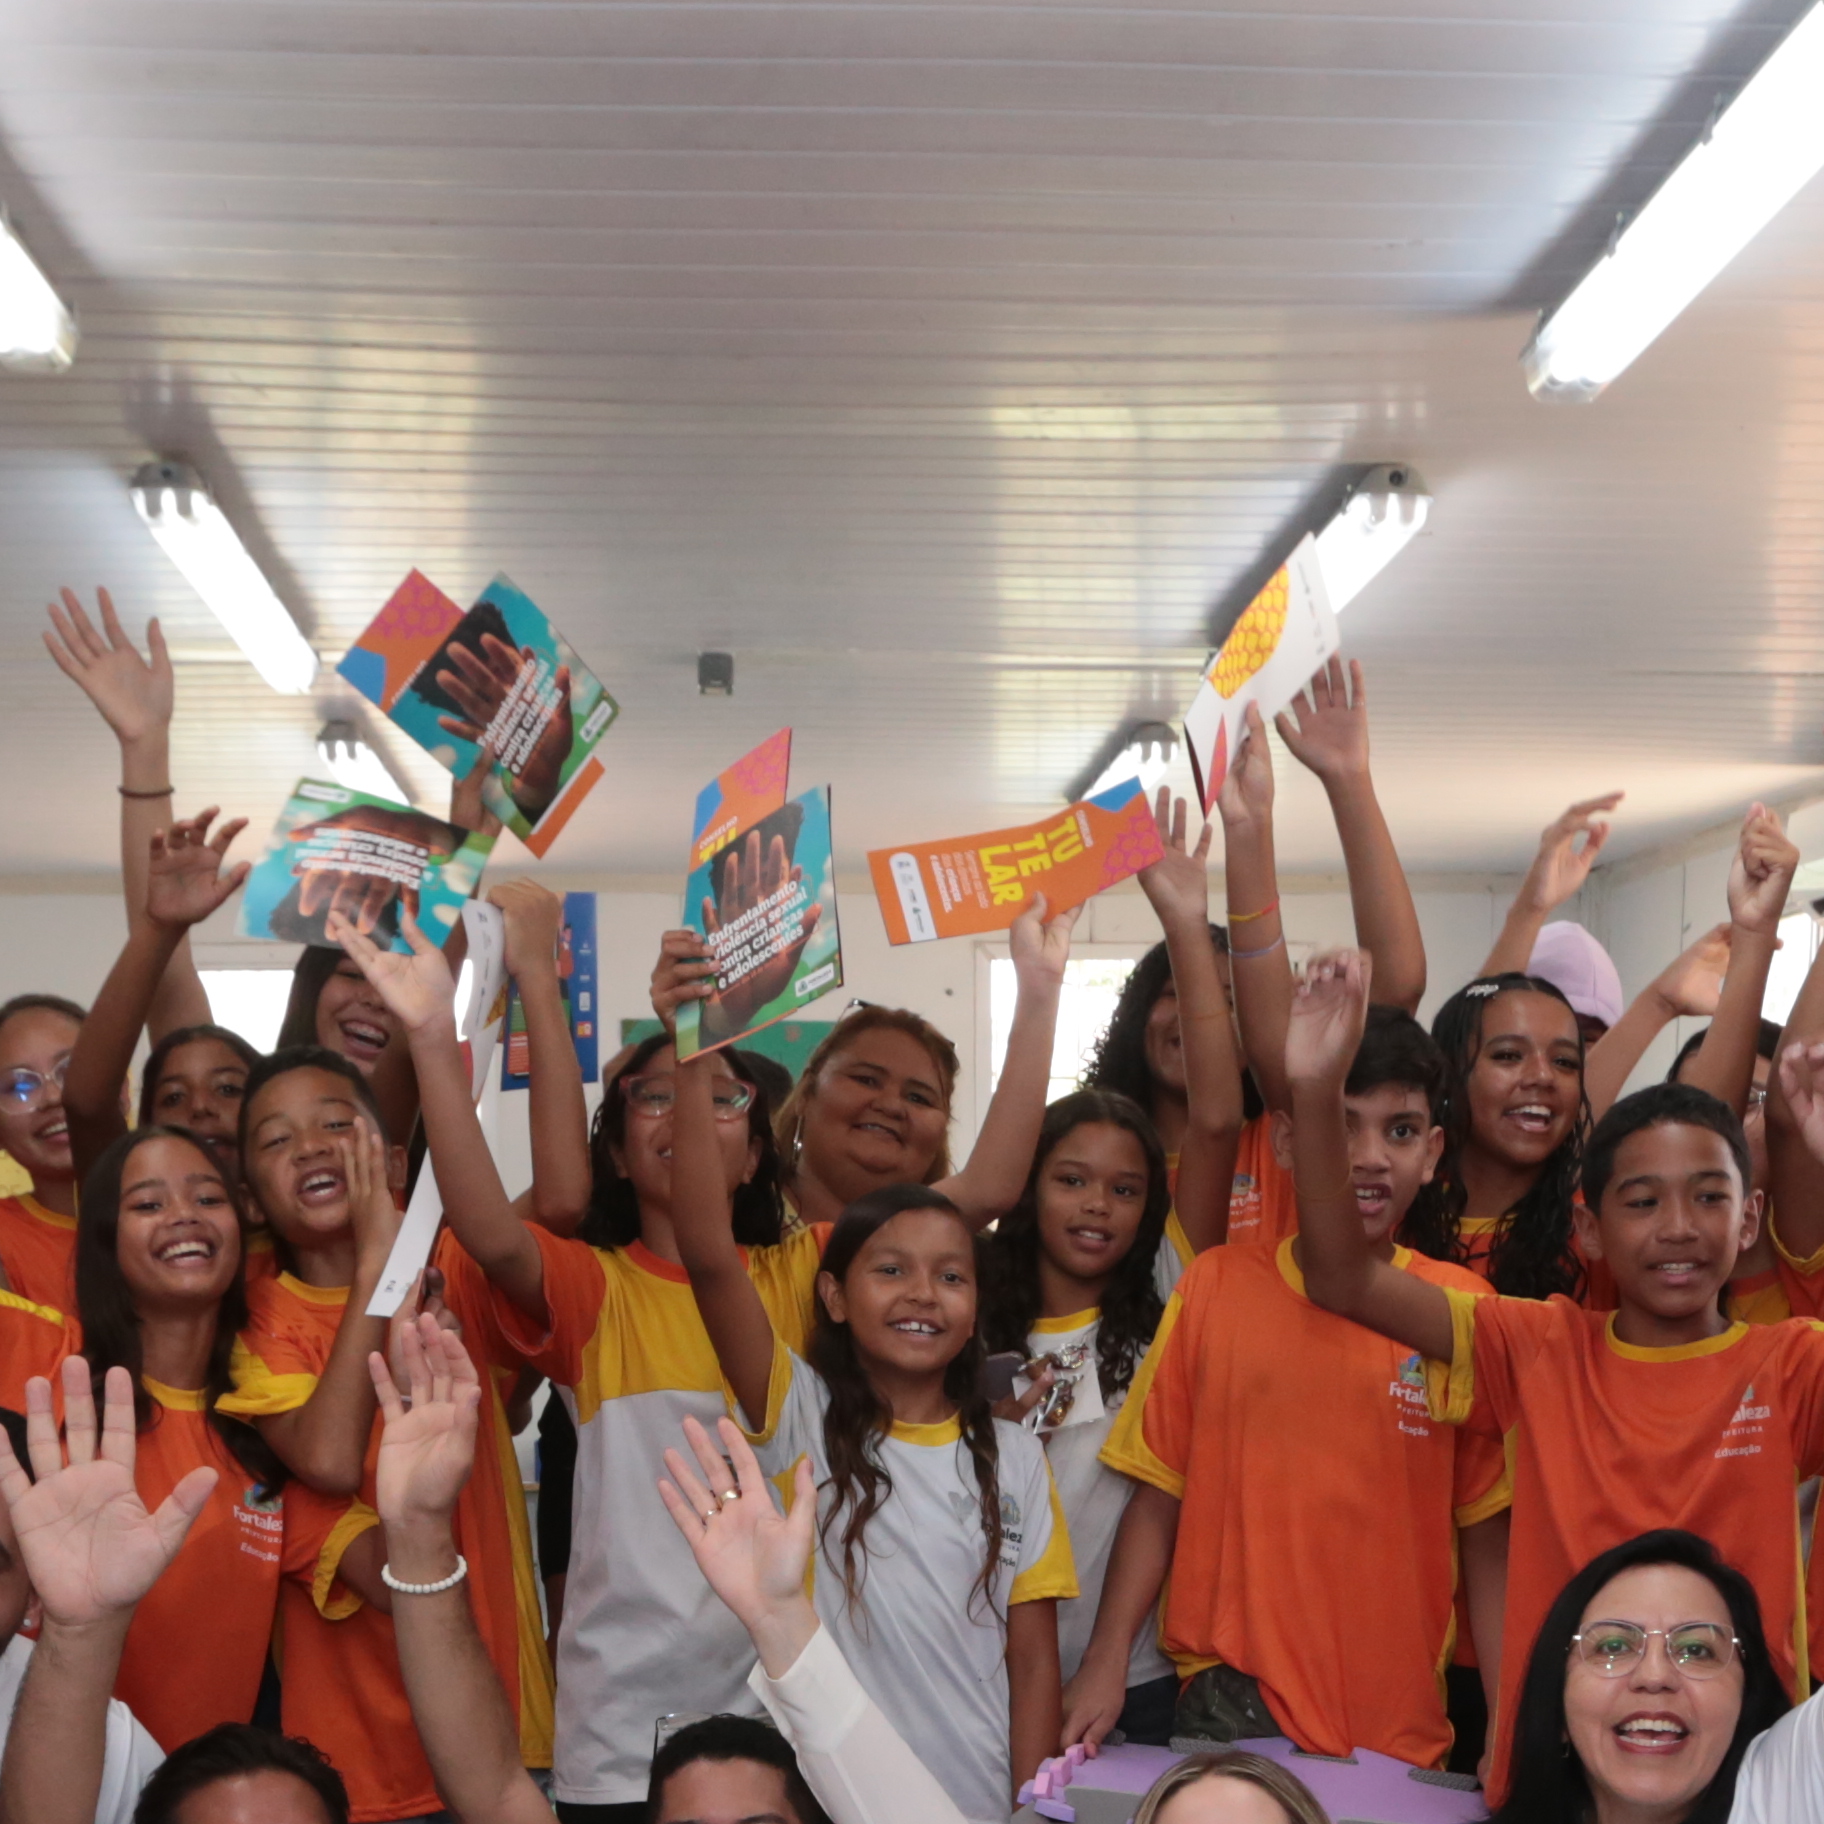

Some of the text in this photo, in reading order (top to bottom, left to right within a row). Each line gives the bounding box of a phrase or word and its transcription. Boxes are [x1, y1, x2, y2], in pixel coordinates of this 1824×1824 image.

[473, 657, 540, 749] Enfrentamento
[495, 675, 559, 767] contra crianças
[509, 686, 569, 774] e adolescentes
[1012, 831, 1053, 877] TE
[1047, 815, 1084, 863] TU
[299, 854, 422, 889] Enfrentamento
[978, 843, 1024, 906] LAR
[704, 878, 800, 947] Enfrentamento
[709, 884, 811, 961] violência sexual
[747, 904, 808, 951] crianças
[714, 975, 730, 990] e
[723, 922, 807, 984] adolescentes
[1730, 1404, 1771, 1424] aleza
[233, 1504, 283, 1532] Fortale
